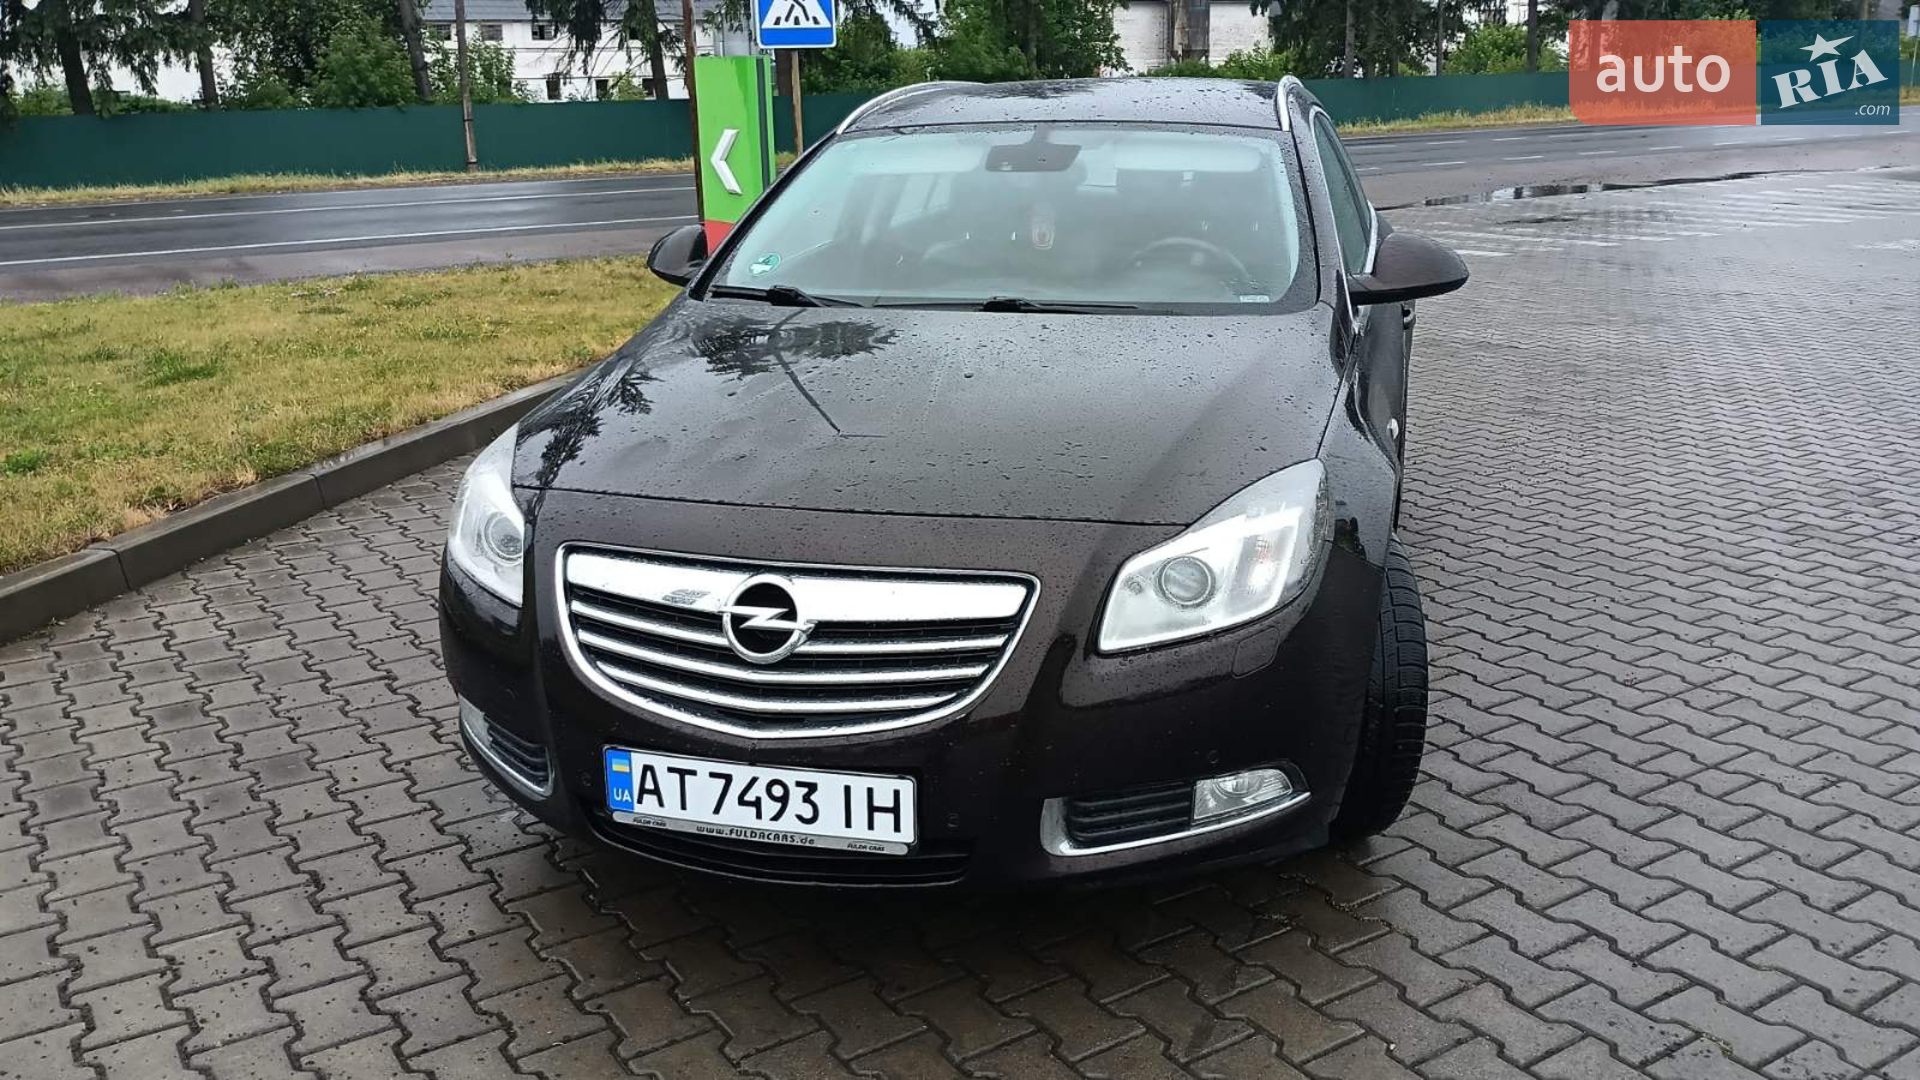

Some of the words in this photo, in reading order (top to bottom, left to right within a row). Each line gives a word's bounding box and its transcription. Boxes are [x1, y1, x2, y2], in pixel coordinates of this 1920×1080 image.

[613, 787, 632, 802] UA
[636, 763, 697, 811] AT
[708, 771, 820, 825] 7493
[843, 784, 901, 833] IH
[696, 825, 815, 845] www.FULDACARS.de
